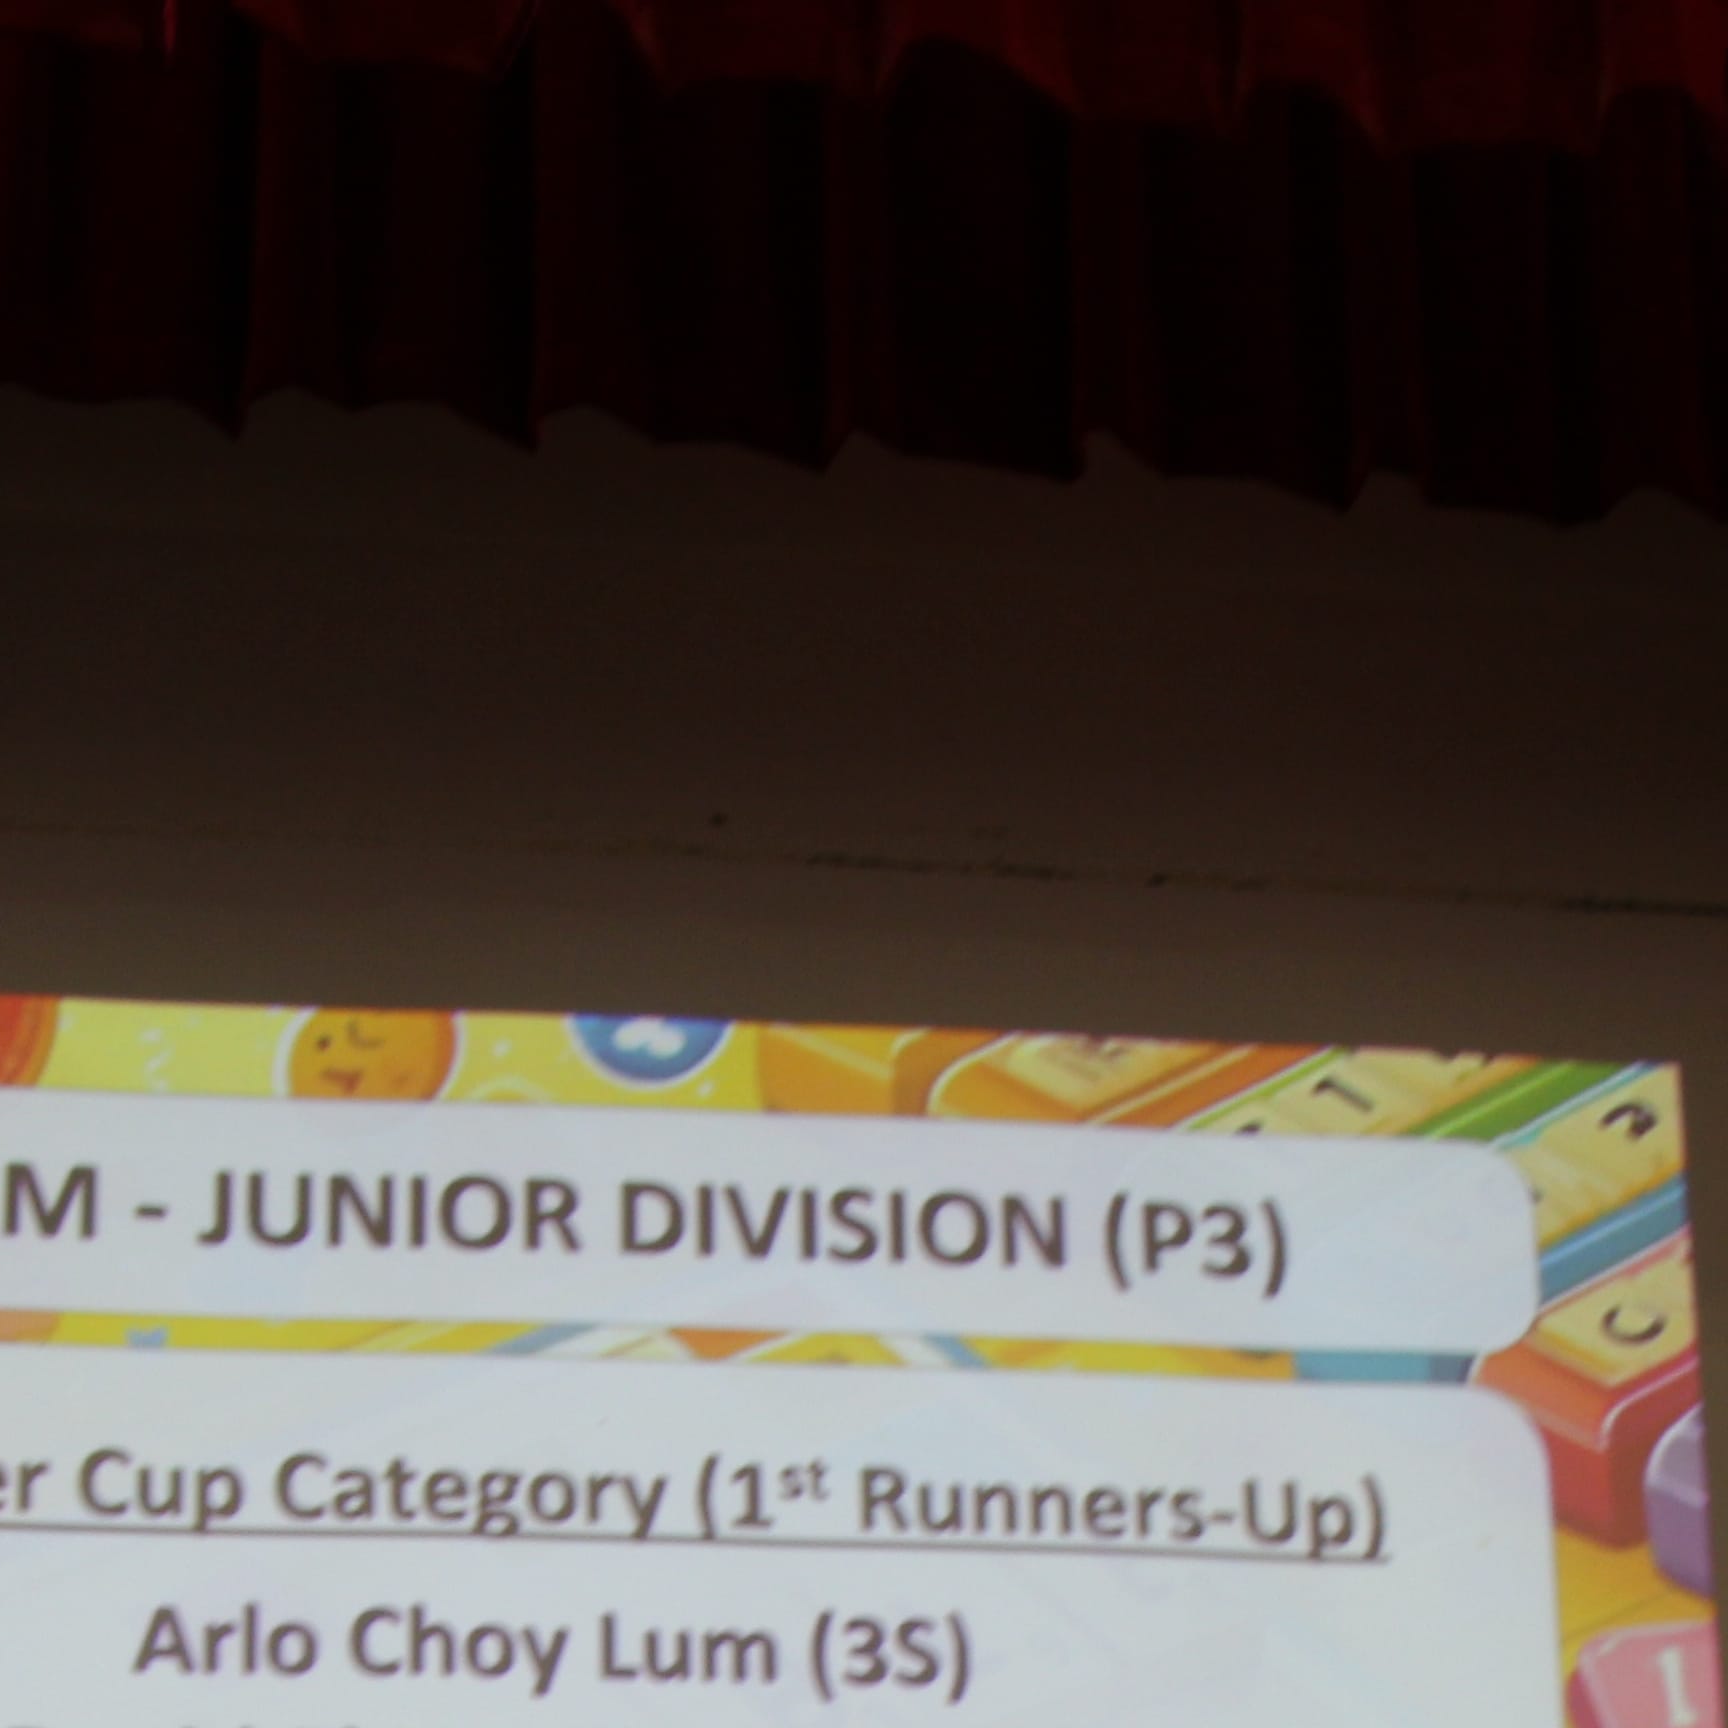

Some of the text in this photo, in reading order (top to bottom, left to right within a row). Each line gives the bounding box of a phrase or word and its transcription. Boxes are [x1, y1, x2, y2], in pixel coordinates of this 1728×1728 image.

[134, 1203, 169, 1221] -
[197, 1169, 582, 1253] JUNIOR
[619, 1180, 1068, 1270] DIVISION
[1103, 1191, 1289, 1300] (P3)
[76, 1446, 246, 1532] Cup
[268, 1451, 670, 1541] Category
[690, 1453, 832, 1542] (1st
[853, 1465, 1388, 1564] Runners-Up)
[132, 1601, 972, 1706] Arlo Choy Lum (3S)
